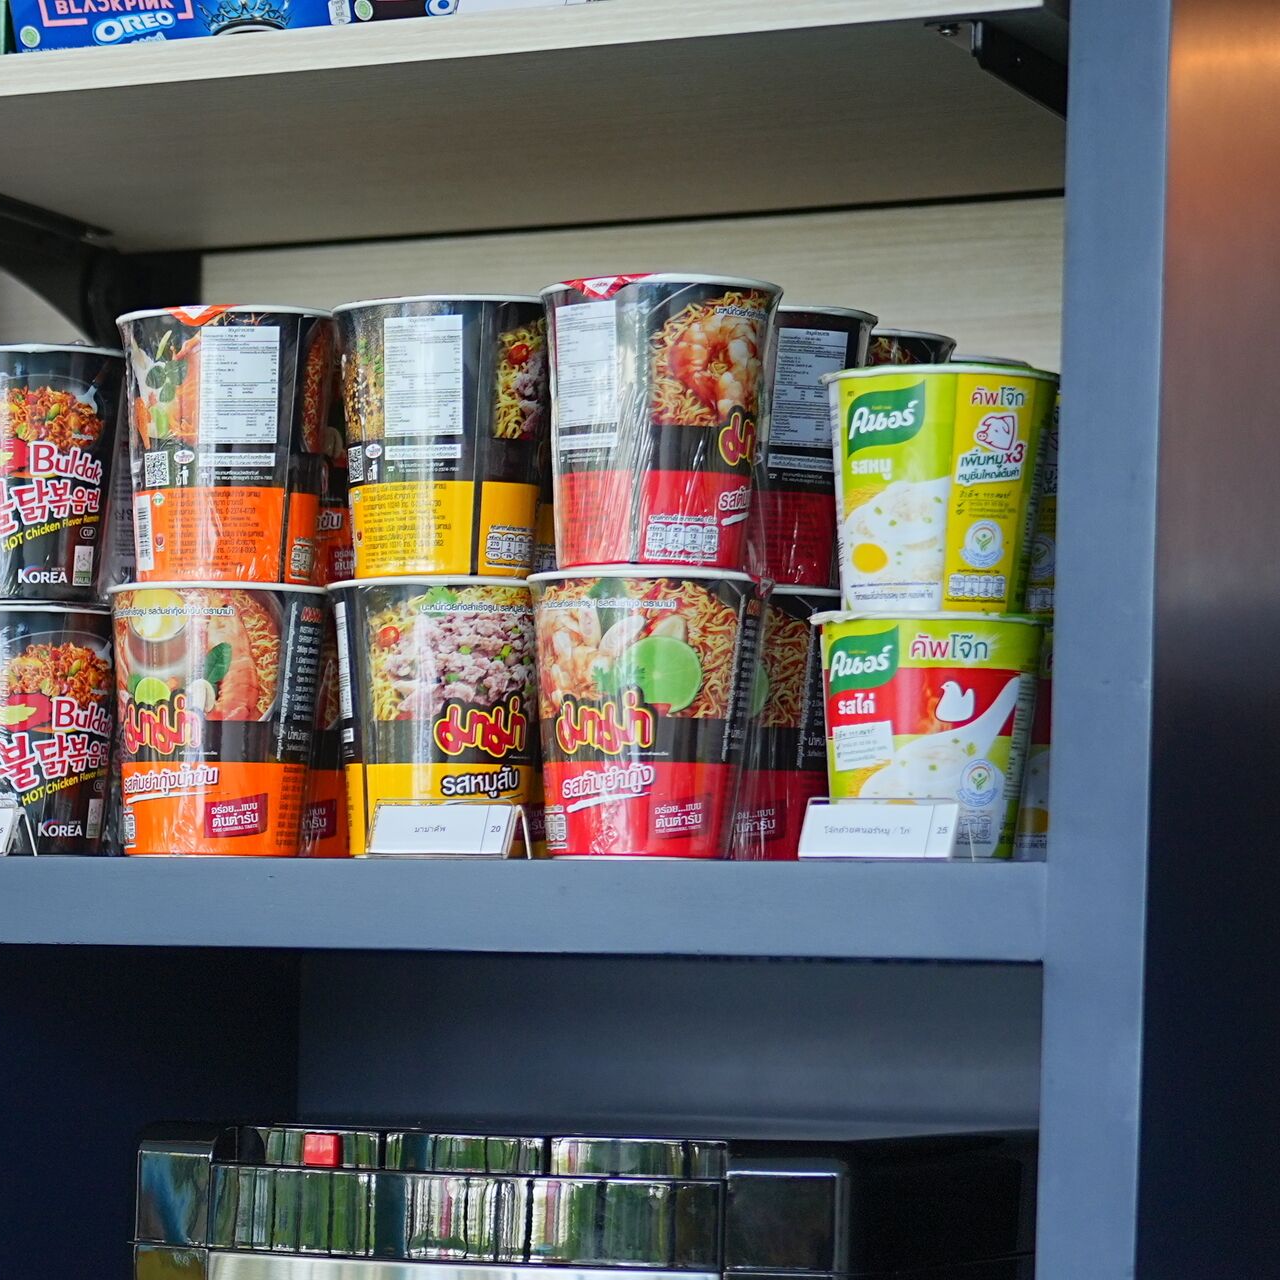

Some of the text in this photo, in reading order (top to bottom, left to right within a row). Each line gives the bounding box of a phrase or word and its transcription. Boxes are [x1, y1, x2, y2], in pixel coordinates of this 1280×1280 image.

[94, 12, 175, 44] OREO
[971, 386, 1025, 406] คัพโจ๊ก
[32, 444, 102, 484] Buldak
[850, 457, 893, 480] รสหมู
[1, 534, 24, 552] HOT
[25, 521, 61, 541] Chicken
[62, 517, 83, 529] Flavor
[82, 529, 94, 537] CUP
[17, 568, 68, 584] KOREA
[910, 634, 989, 660] คัพโจ๊ก
[837, 693, 876, 716] รสไก่
[434, 696, 527, 757] มาม่า
[555, 690, 654, 755] มาม่า
[21, 787, 44, 806] HOT
[45, 774, 80, 796] Chicken
[441, 765, 520, 799] รสหมูสับ
[38, 822, 83, 837] KOREA
[212, 812, 259, 829] ต้นตำรับ
[490, 825, 501, 833] 20
[936, 826, 948, 835] 25
